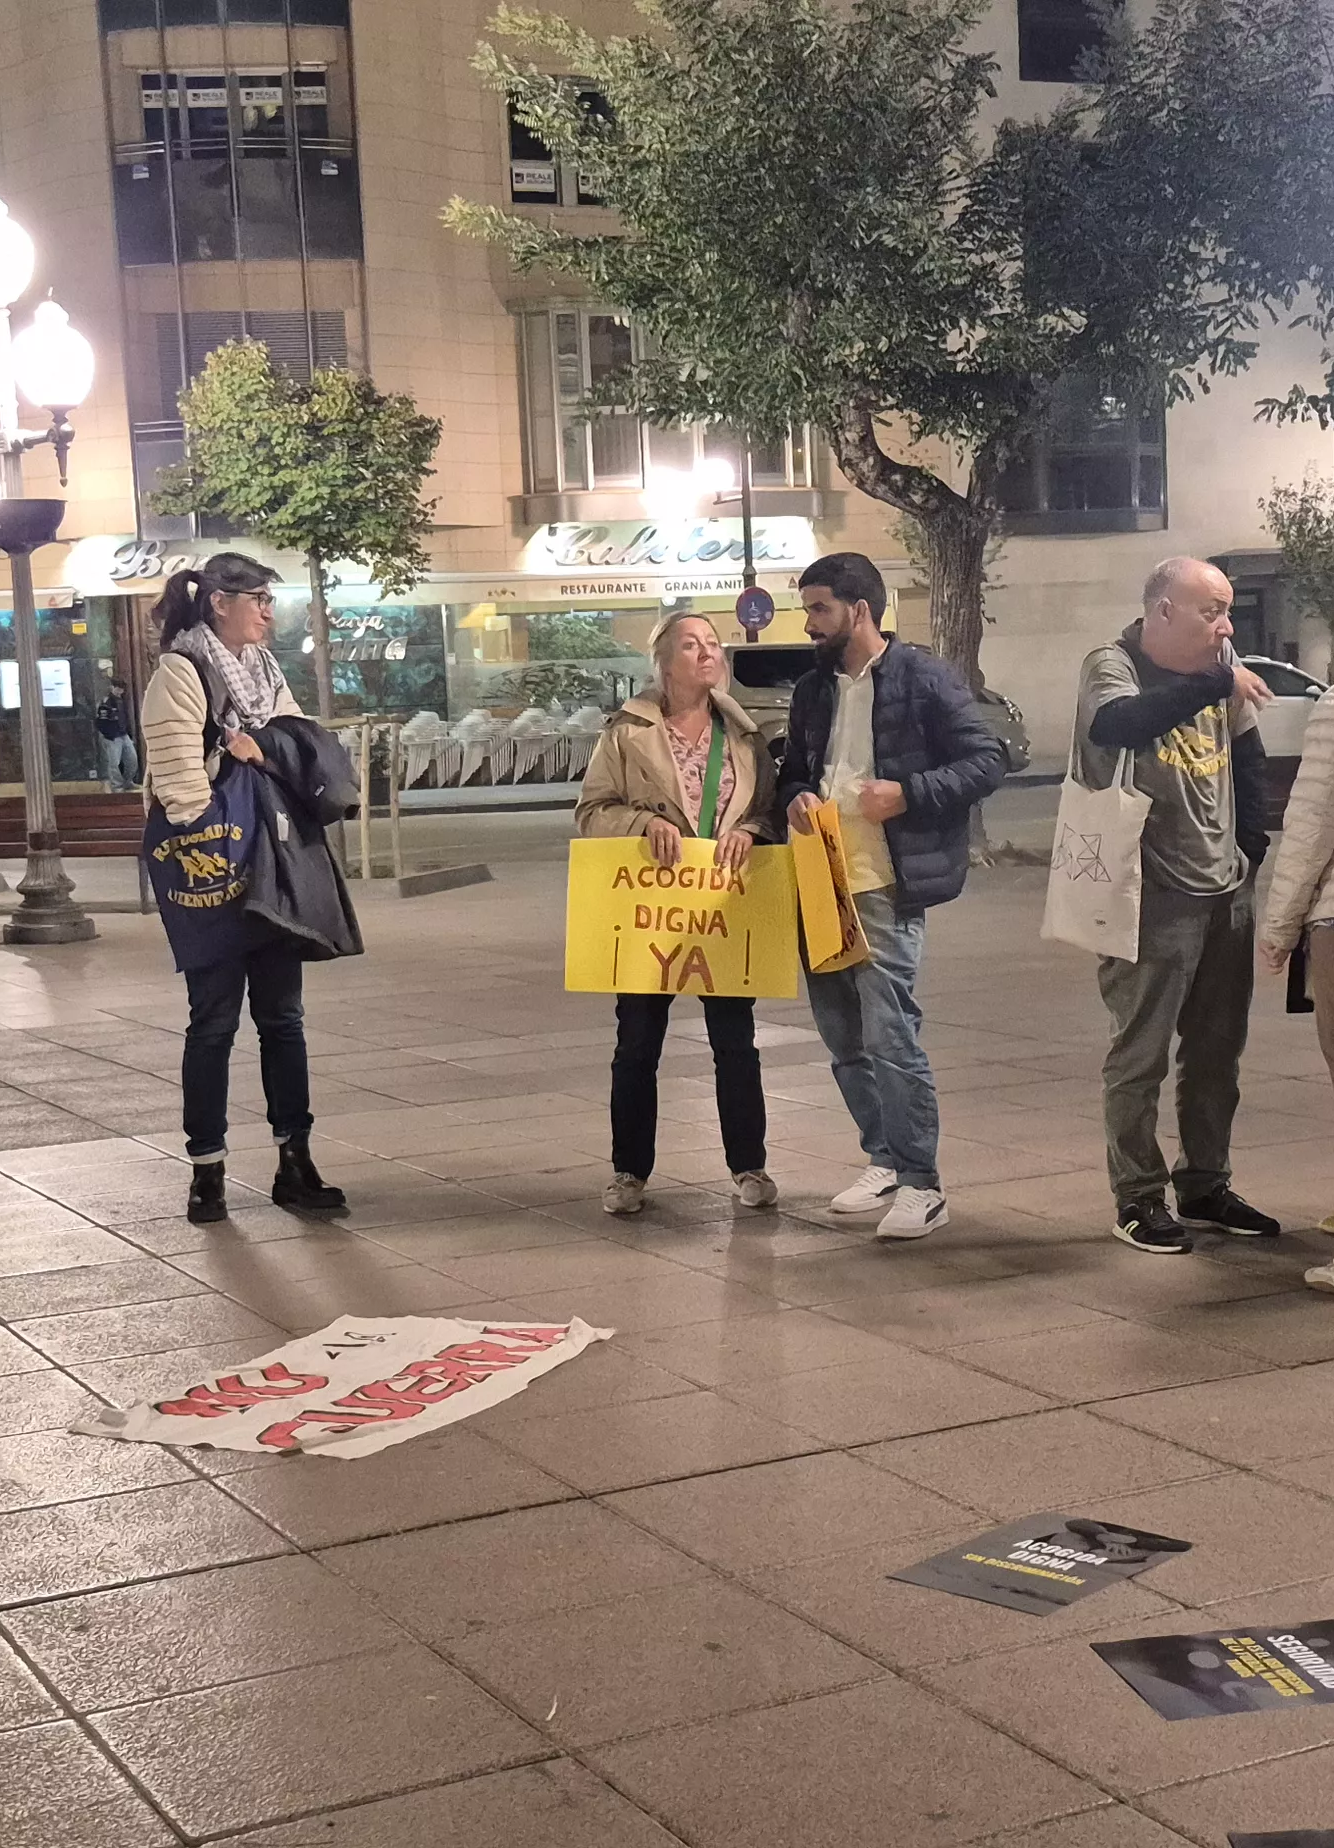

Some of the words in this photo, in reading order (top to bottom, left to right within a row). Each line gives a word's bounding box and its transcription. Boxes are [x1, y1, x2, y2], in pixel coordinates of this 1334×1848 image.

[560, 582, 647, 596] RESTAURANTE
[664, 580, 712, 593] GRANJA
[715, 578, 743, 591] ANIT
[612, 865, 746, 895] ACOGIDA
[634, 904, 729, 938] DIGNA
[1007, 1550, 1077, 1572] DIGNA
[1012, 1539, 1109, 1566] ACOGIDA
